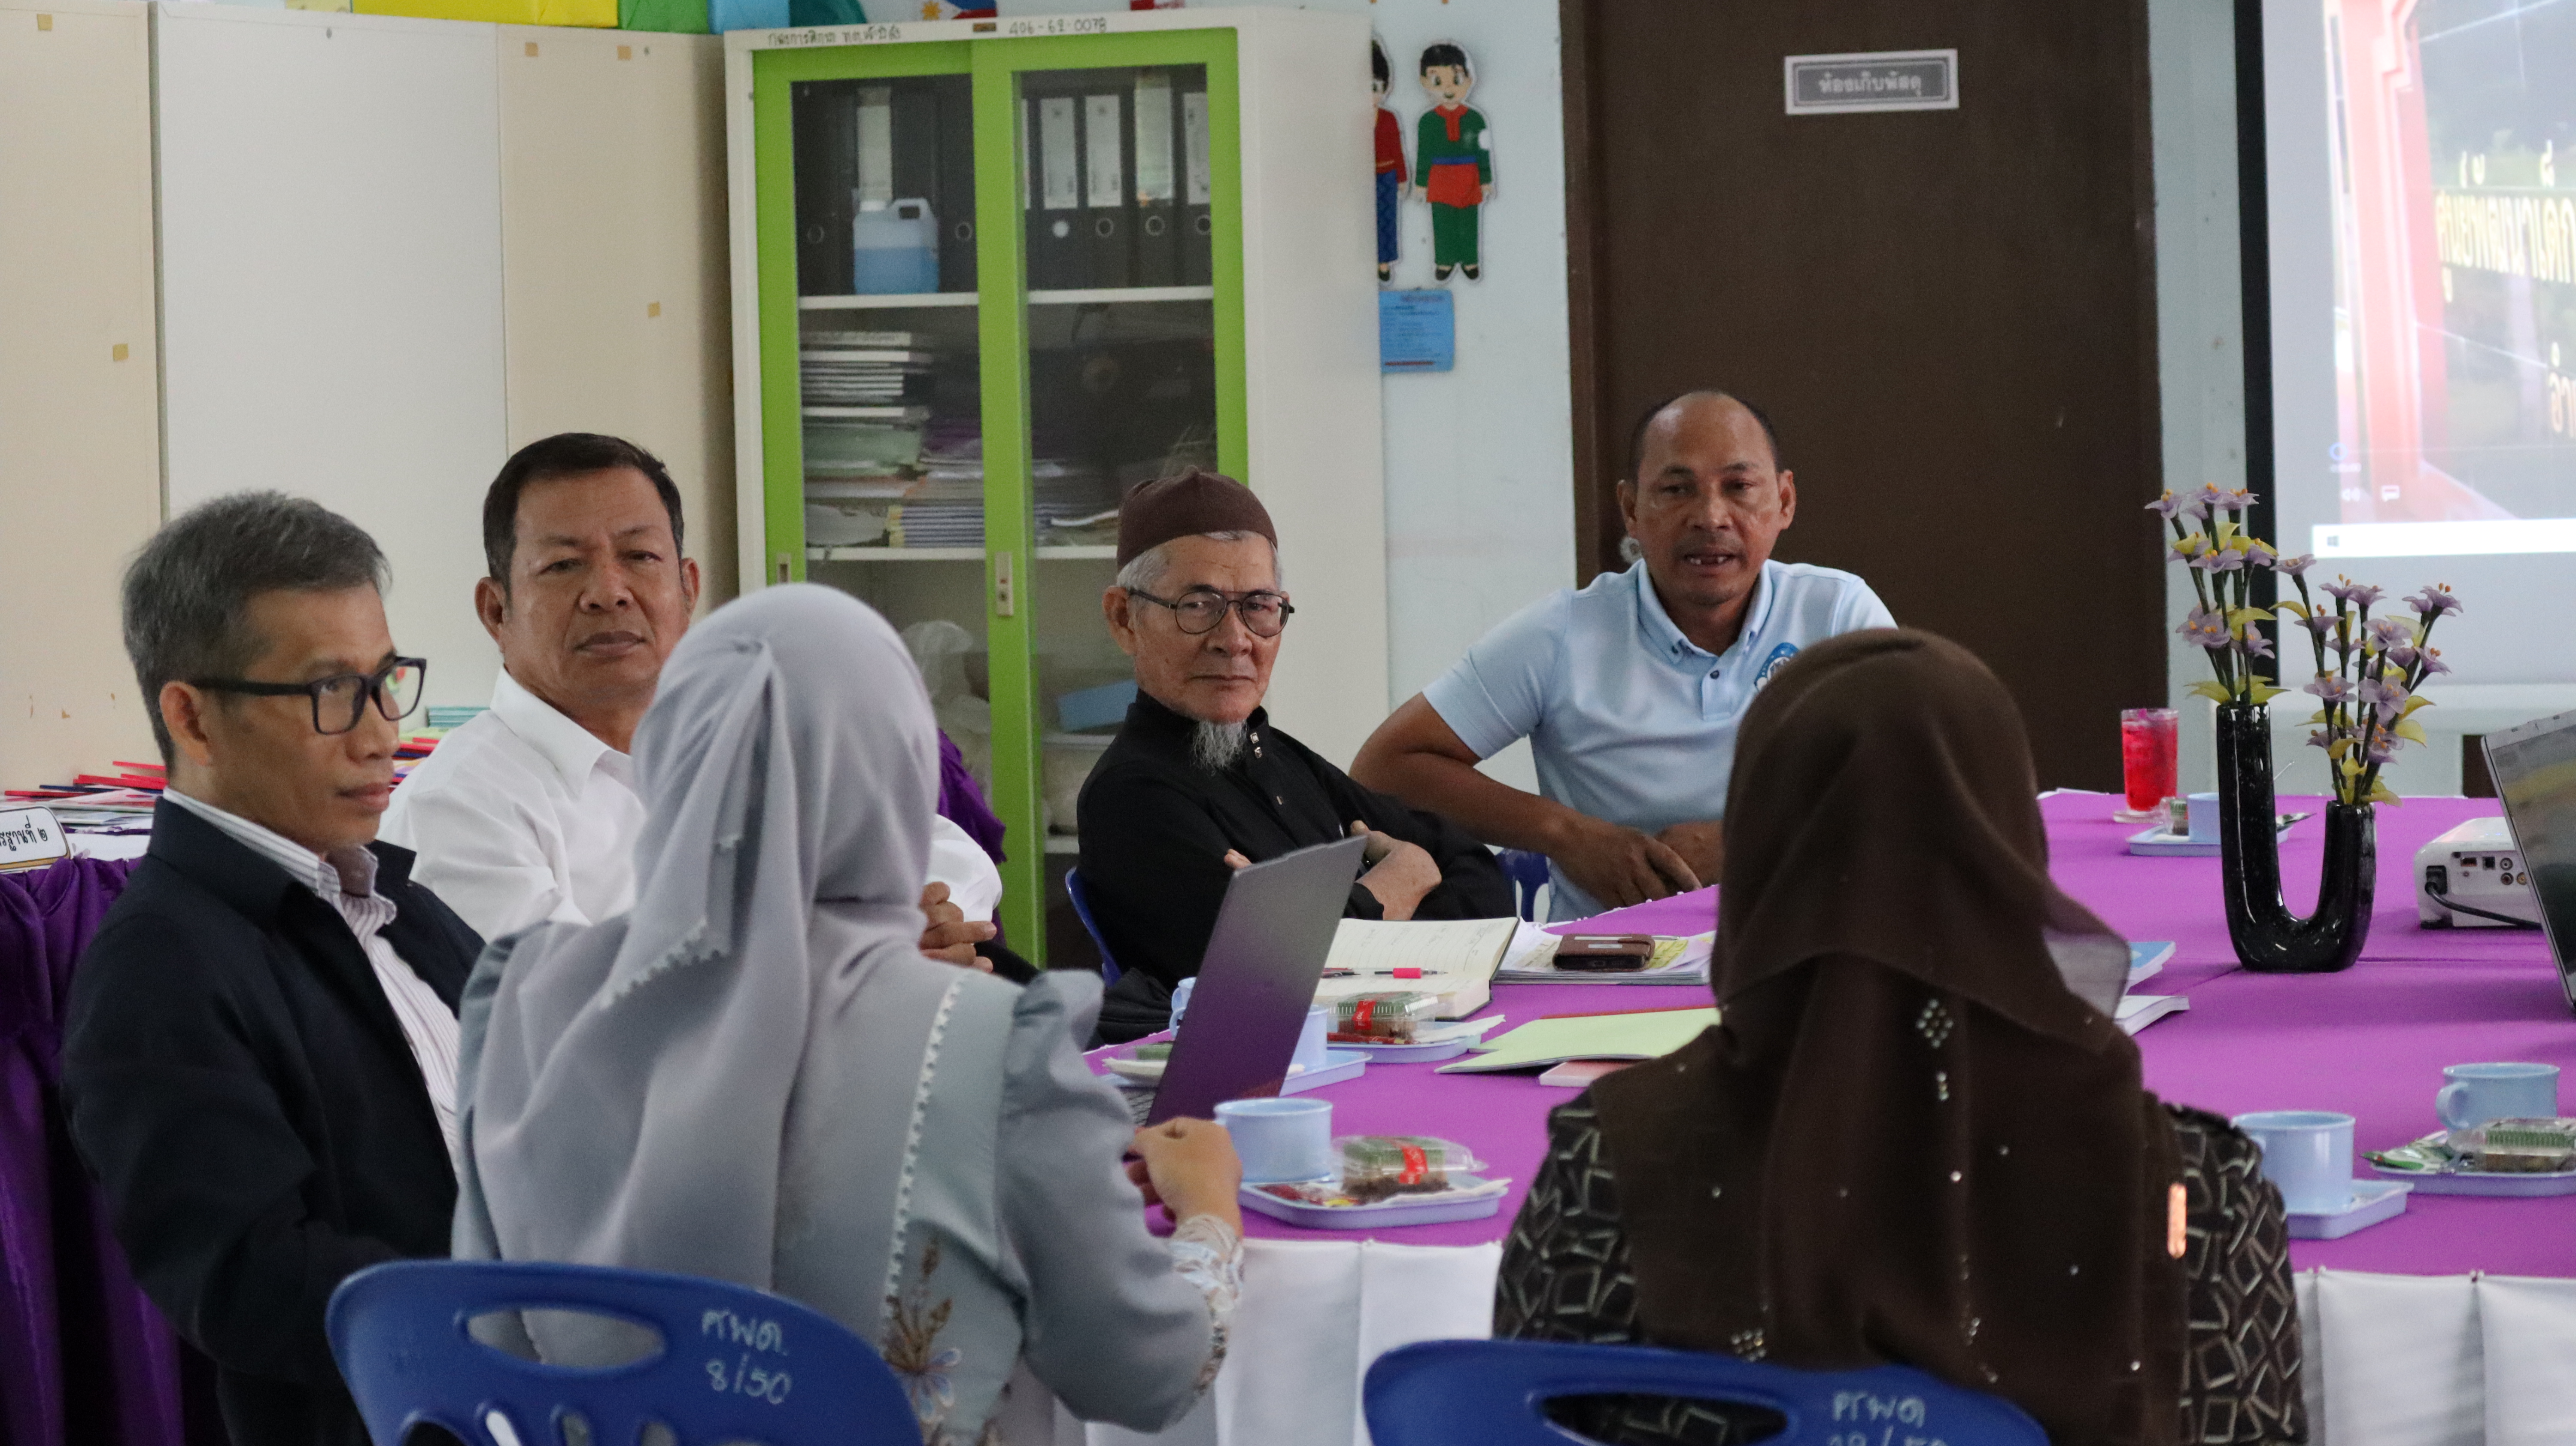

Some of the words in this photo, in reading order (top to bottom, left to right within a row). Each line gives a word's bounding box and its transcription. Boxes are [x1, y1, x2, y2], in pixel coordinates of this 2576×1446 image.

[1819, 70, 1922, 97] ห้องเก็บพัสดุ
[0, 815, 37, 851] รฐานที่
[37, 827, 48, 841] ๒
[705, 1353, 793, 1405] 8/50
